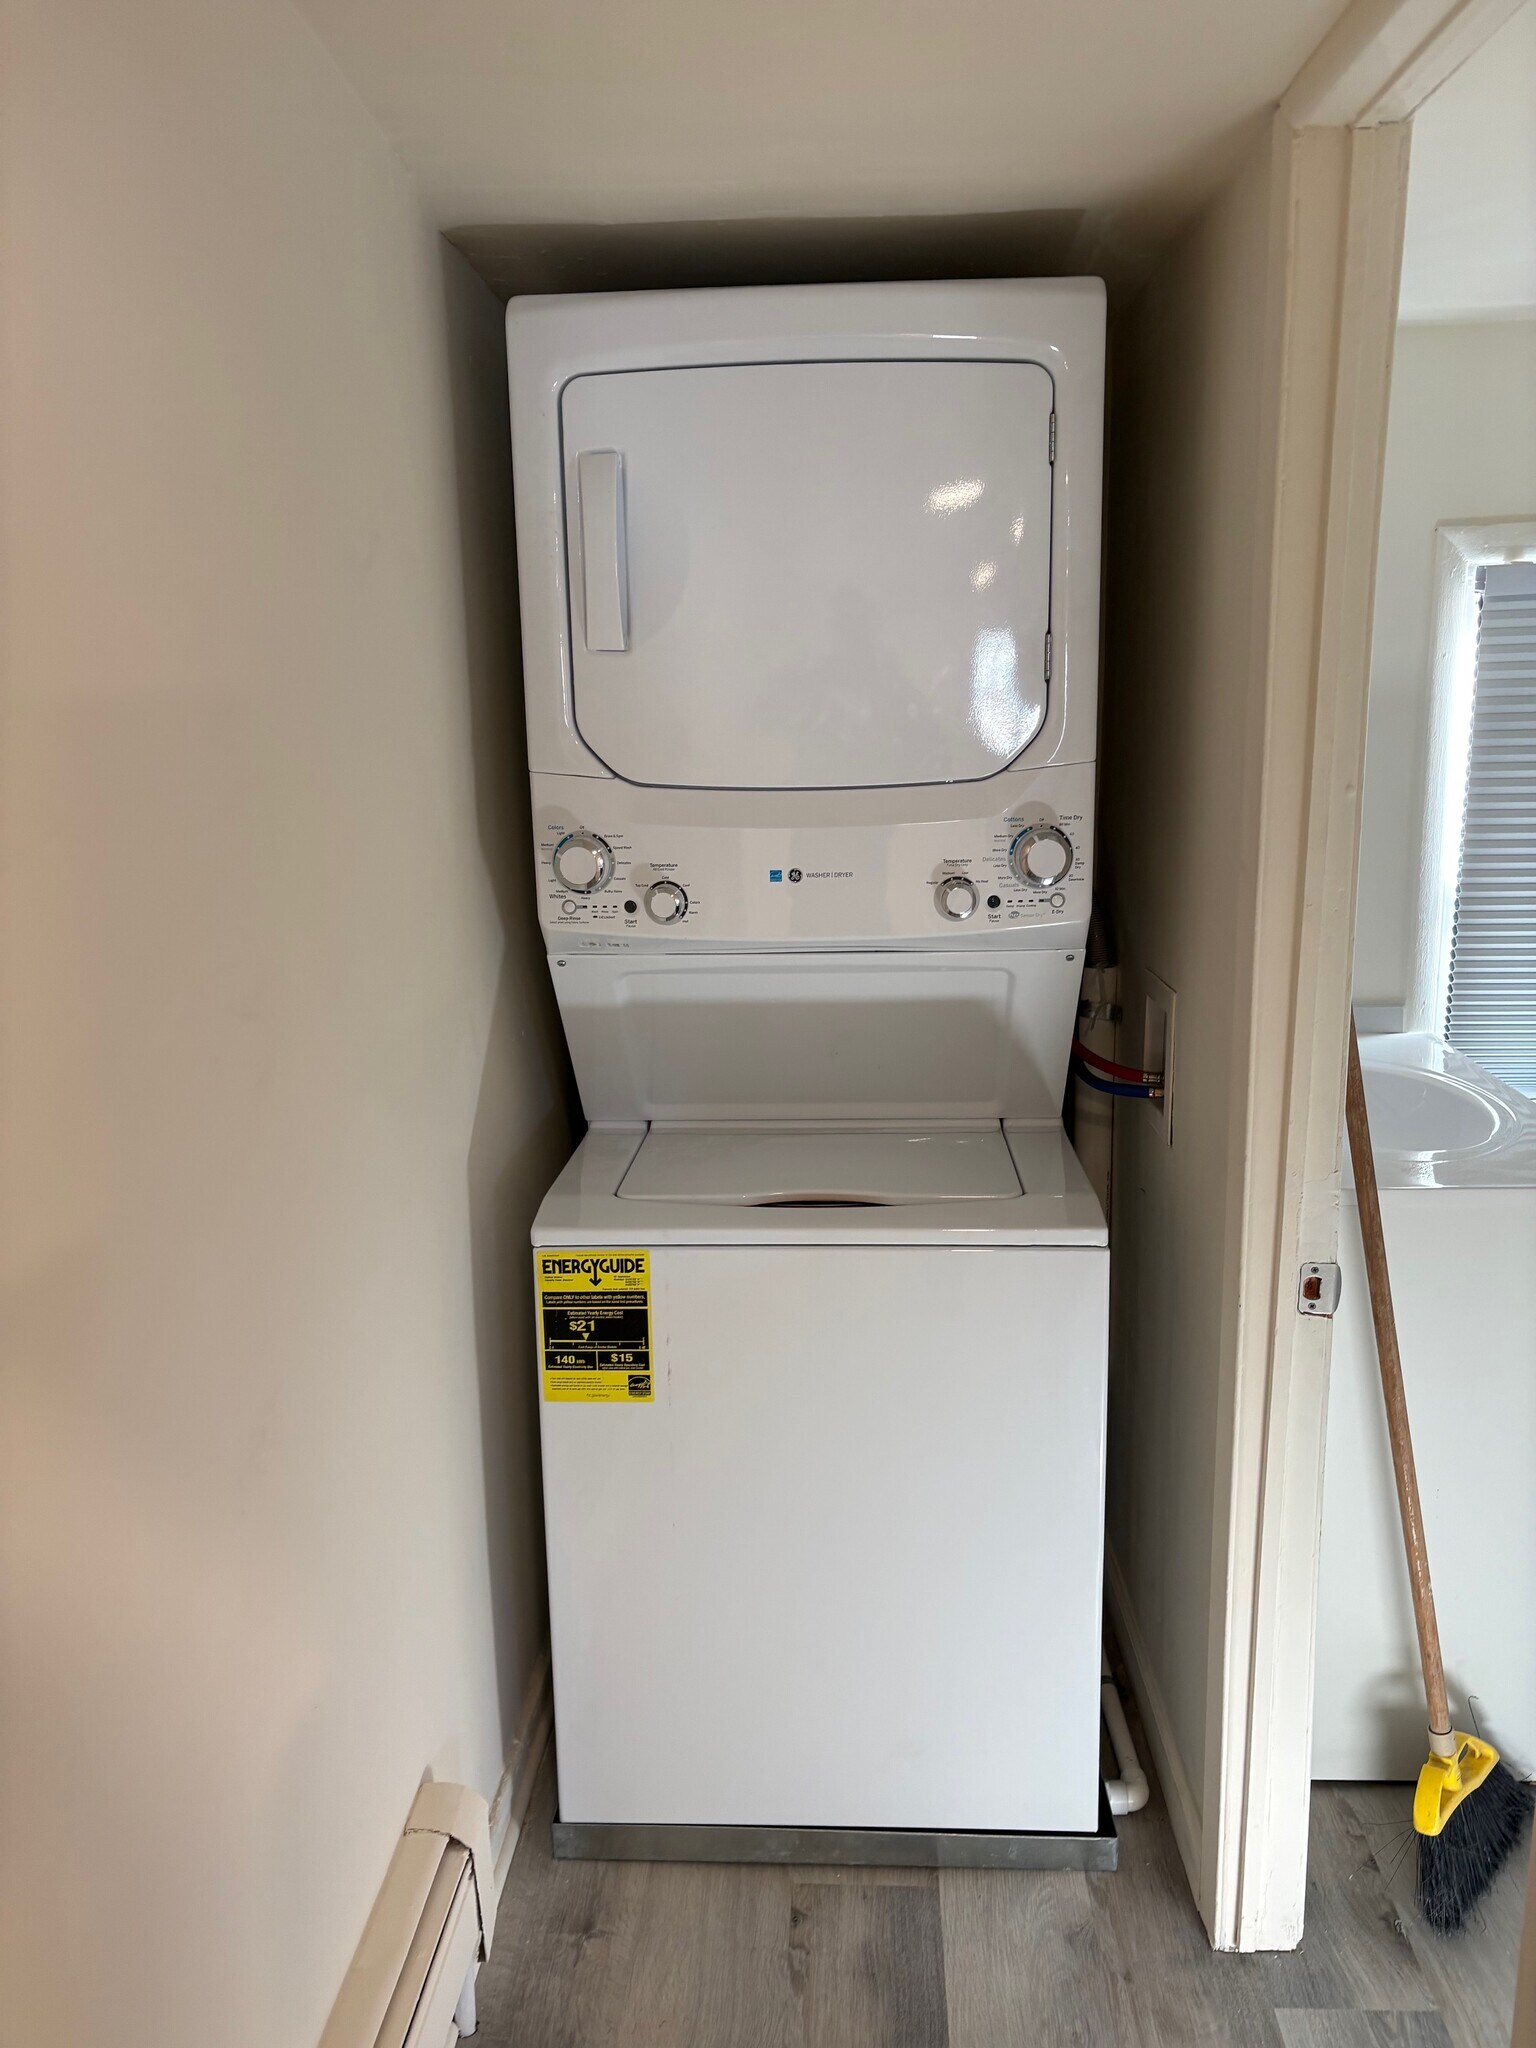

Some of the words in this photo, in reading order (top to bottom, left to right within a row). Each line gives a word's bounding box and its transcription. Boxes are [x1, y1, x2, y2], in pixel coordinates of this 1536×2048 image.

[541, 1258, 645, 1274] ENERGYGUIDE
[569, 1320, 595, 1332] $21
[555, 1355, 576, 1364] 140
[610, 1353, 634, 1363] $15
